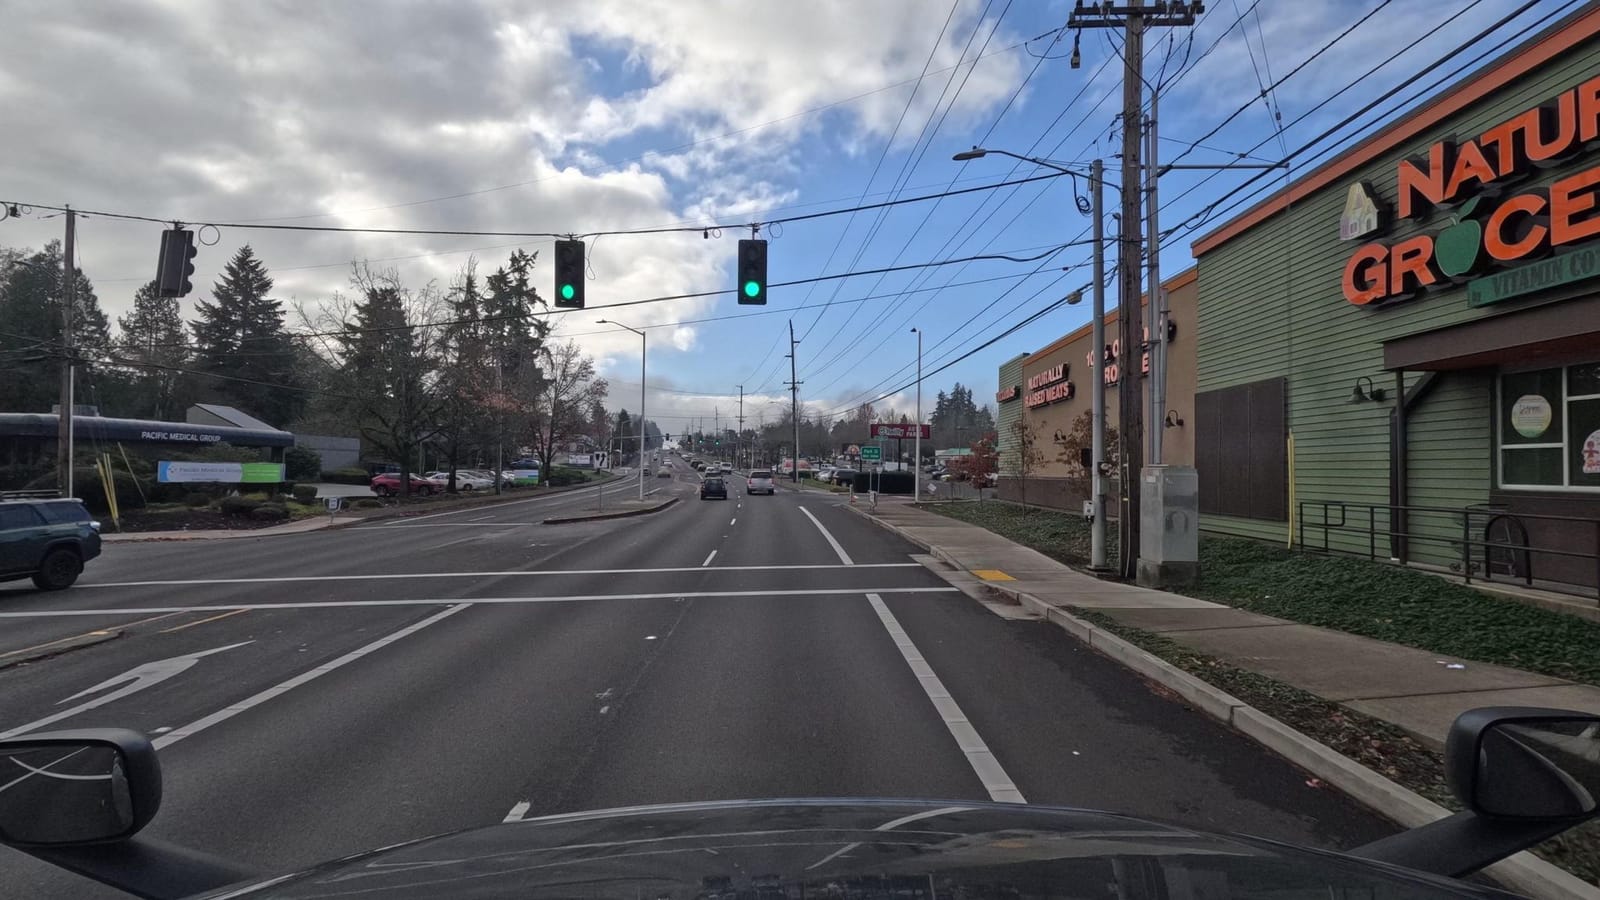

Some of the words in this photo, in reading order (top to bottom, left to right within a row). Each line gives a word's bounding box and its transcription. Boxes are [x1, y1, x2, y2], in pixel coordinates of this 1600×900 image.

[1491, 261, 1563, 299] VITAMIN
[1028, 364, 1064, 390] NATURALLY
[1024, 390, 1046, 408] RAISED
[1046, 382, 1069, 402] MEATS
[142, 431, 168, 440] PACIFIC
[170, 433, 199, 441] MEDICAL
[200, 434, 221, 442] GROUP
